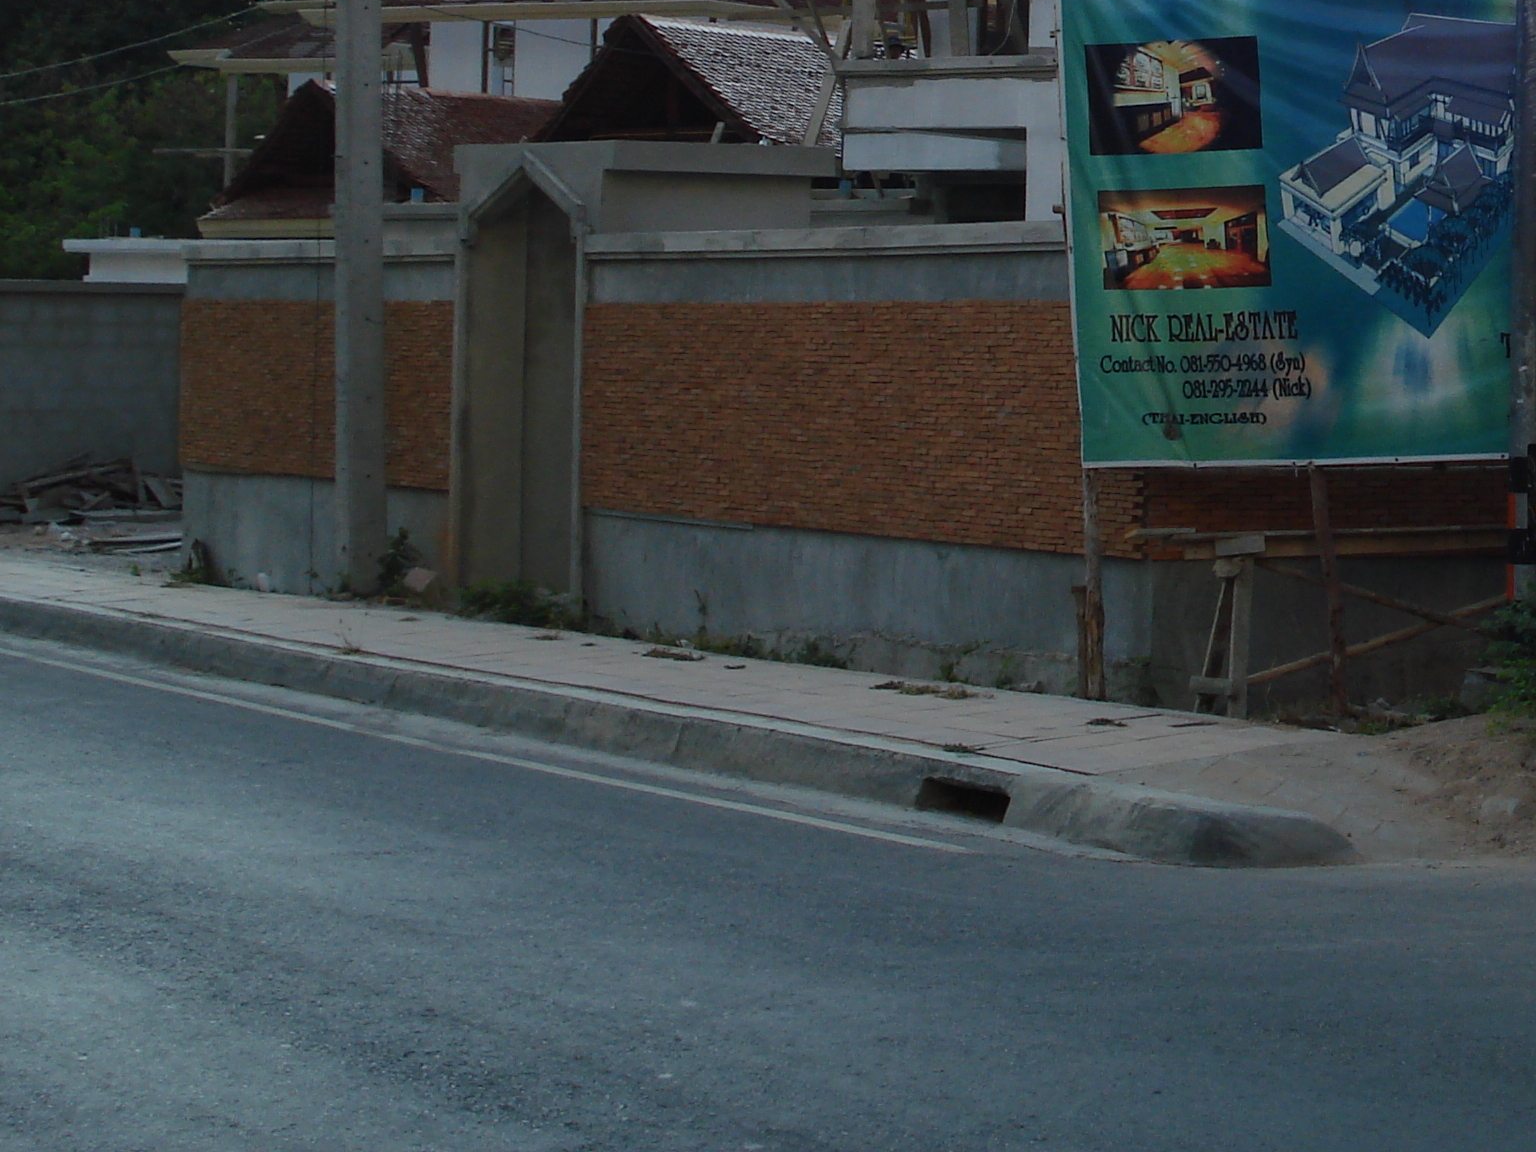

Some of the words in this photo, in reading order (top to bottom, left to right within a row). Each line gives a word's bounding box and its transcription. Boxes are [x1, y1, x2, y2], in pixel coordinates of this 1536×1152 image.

[1110, 314, 1161, 343] NICK
[1167, 310, 1298, 343] REAL-ESTATE
[1100, 355, 1155, 374] Contact
[1157, 356, 1177, 373] No.
[1180, 354, 1266, 373] 081-550-4968
[1270, 351, 1305, 375] (Syn)
[1183, 378, 1268, 398] 081-295-2244
[1273, 378, 1312, 400] (Nick)
[1142, 412, 1267, 426] (THAI-ENGLISH)
